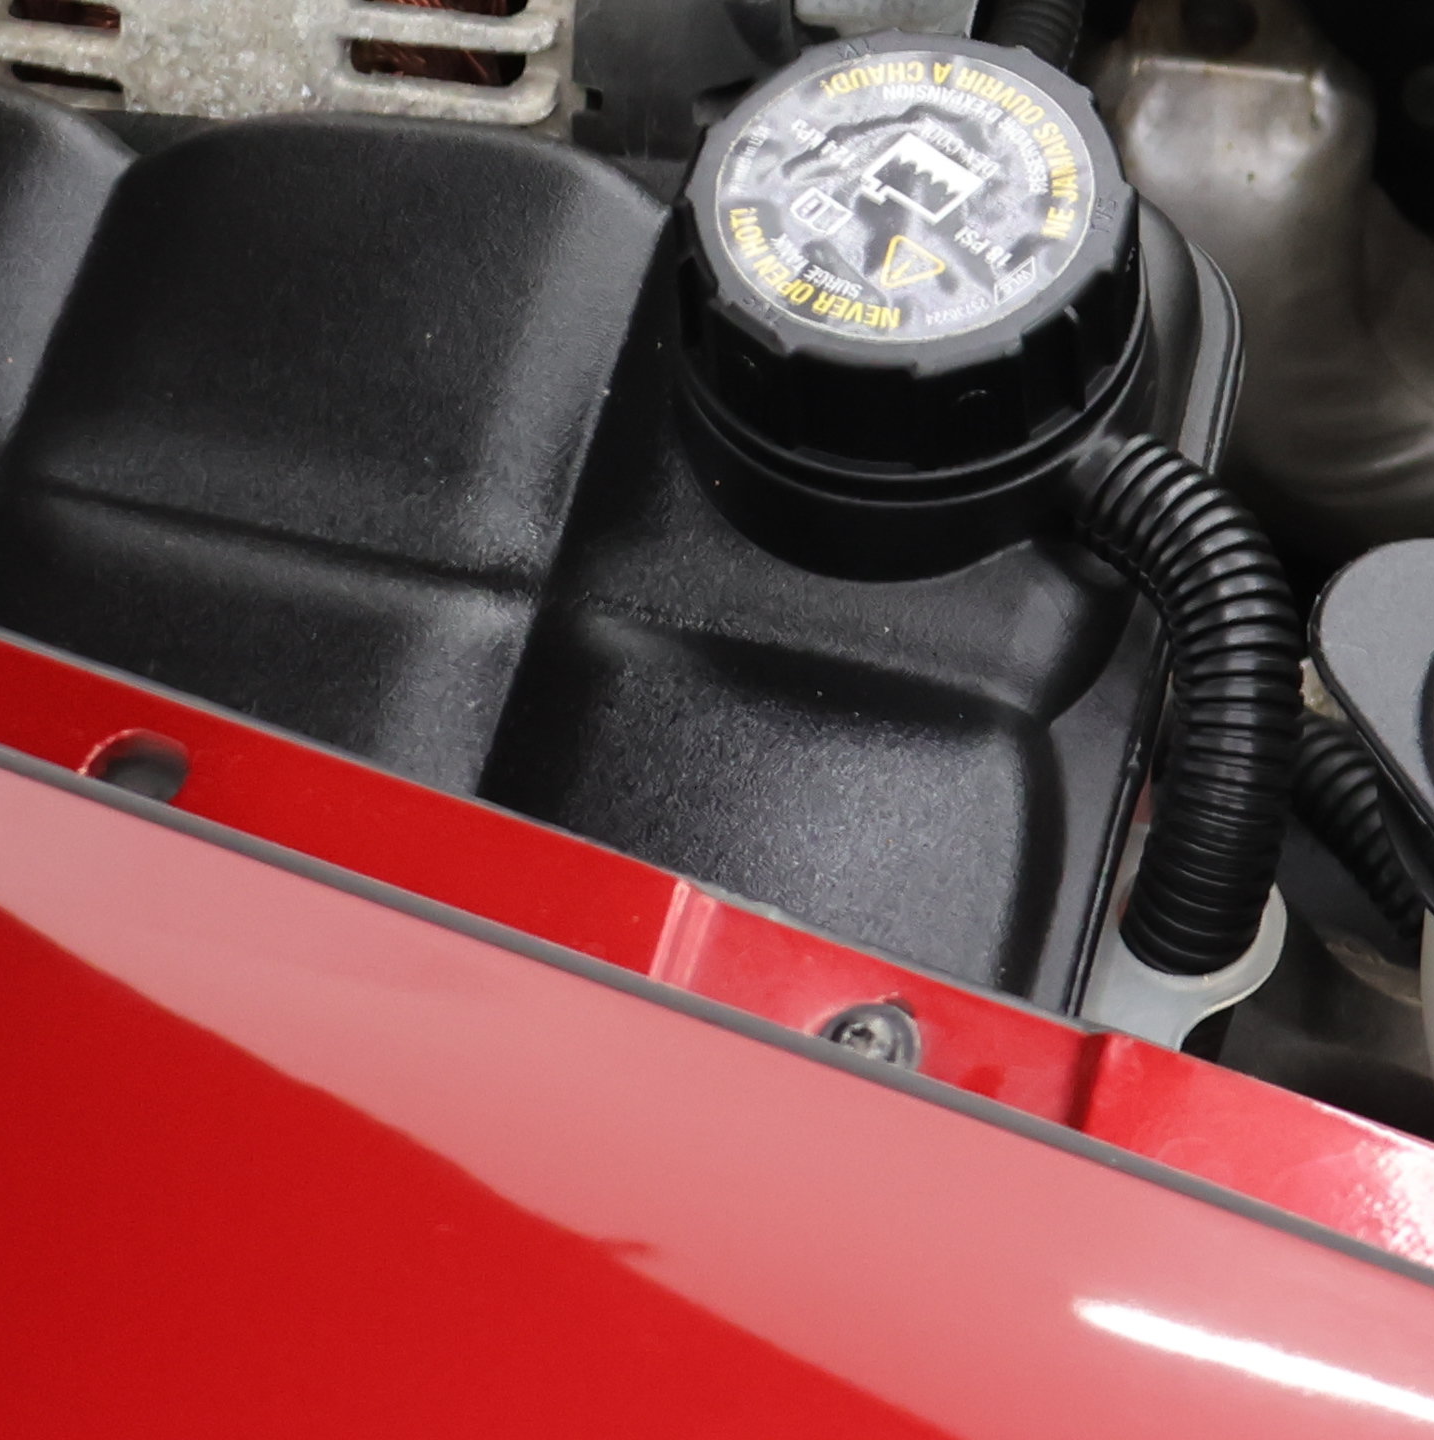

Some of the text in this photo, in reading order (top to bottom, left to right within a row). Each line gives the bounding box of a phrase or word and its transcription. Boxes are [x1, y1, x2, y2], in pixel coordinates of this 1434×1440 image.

[820, 60, 925, 99] CHAUD!
[955, 65, 1046, 125] OUVRIR
[1034, 121, 1079, 202] JAMAIS
[729, 207, 770, 258] HOT!
[954, 225, 991, 256] PSI
[1041, 206, 1075, 240] NE
[753, 255, 816, 306] OPEN
[769, 232, 864, 299] SURGE TANK
[812, 296, 903, 329] NEVER
